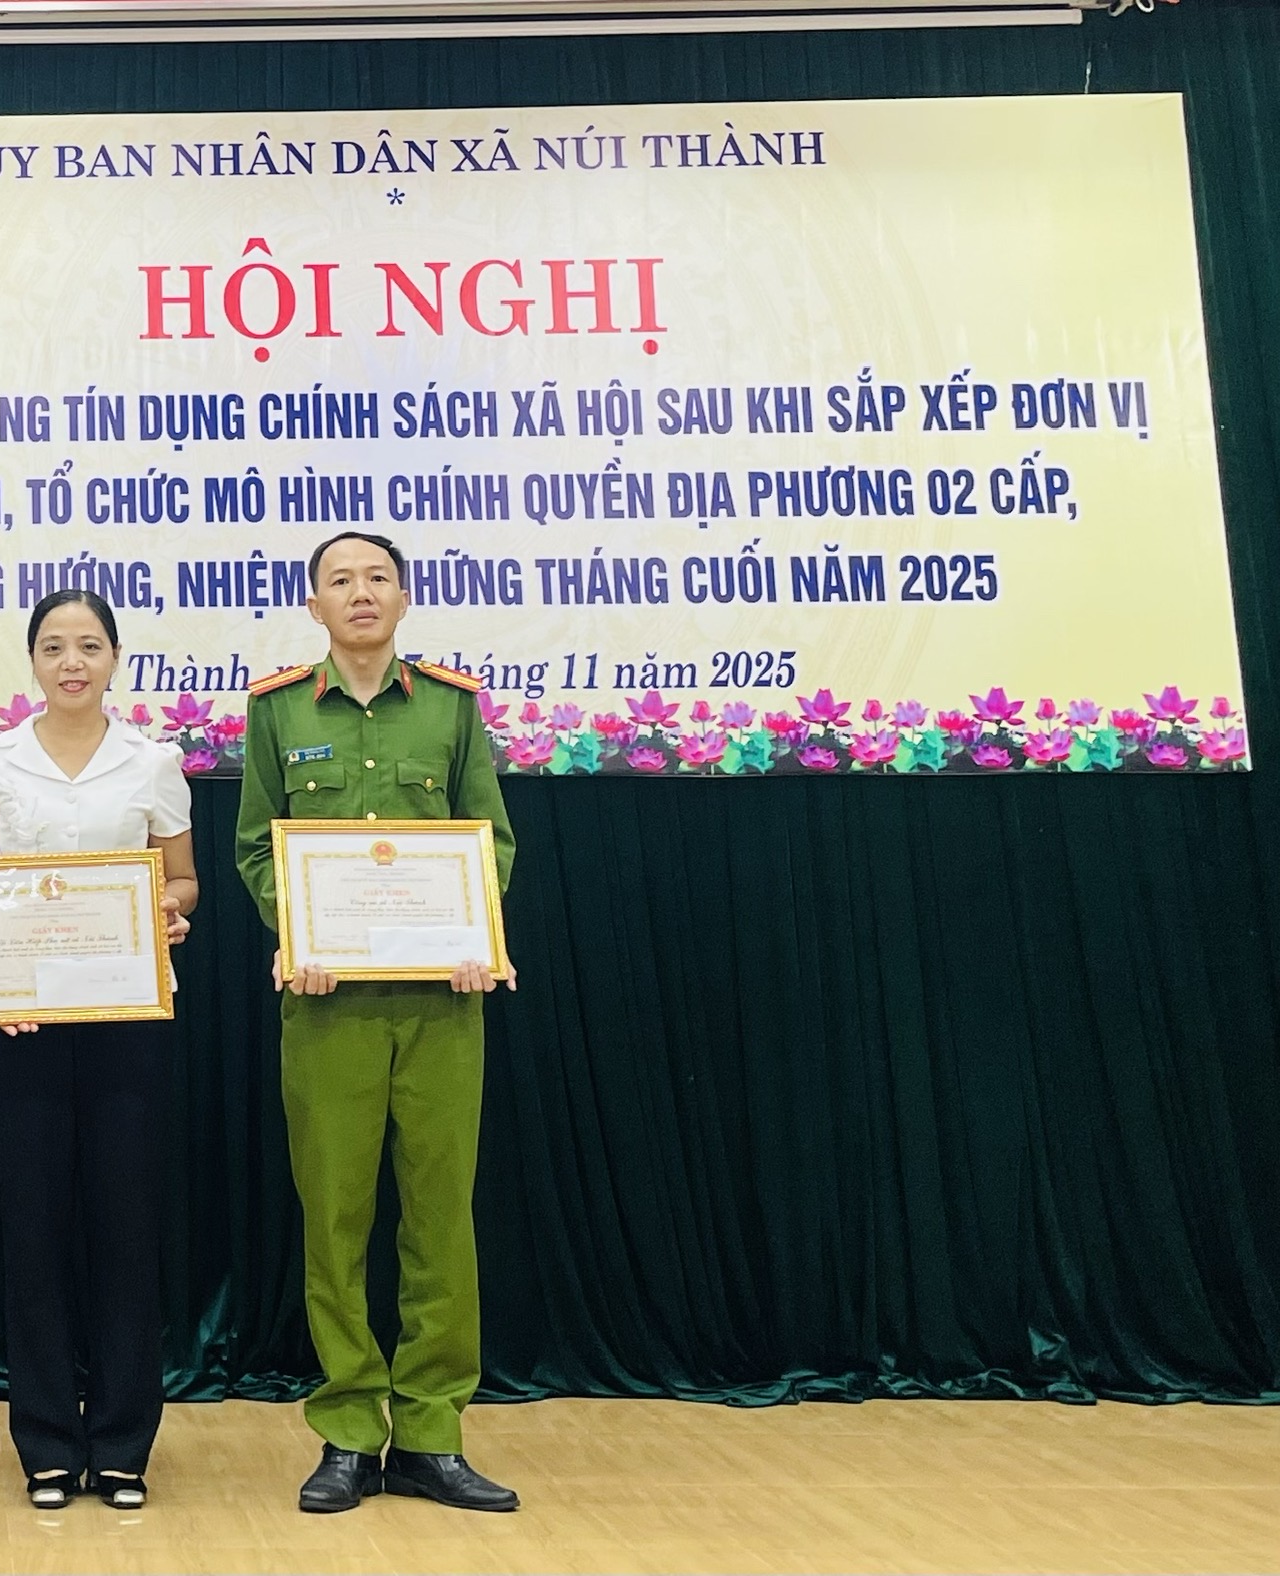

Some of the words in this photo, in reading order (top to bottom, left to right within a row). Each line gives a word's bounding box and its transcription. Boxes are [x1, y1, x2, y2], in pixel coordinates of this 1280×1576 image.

[54, 145, 155, 178] BAN
[173, 132, 315, 176] NHÂN
[332, 130, 437, 174] DÂN
[453, 129, 518, 171] XÃ
[535, 125, 632, 171] NÚI
[641, 122, 827, 169] THÀNH
[139, 238, 340, 362] HỘI
[376, 259, 667, 354] NGHỊ
[64, 386, 124, 441] TÍN
[139, 394, 245, 451] DỤNG
[260, 383, 378, 440] CHÍNH
[394, 382, 498, 438] SÁCH
[512, 381, 565, 436] XÃ
[578, 380, 642, 445] HỘI
[658, 388, 732, 435] SAU
[747, 387, 813, 433] KHI
[828, 368, 905, 432] SẮP
[921, 369, 997, 430] XẾP
[1012, 379, 1096, 428] ĐƠN
[1110, 383, 1147, 439] VỊ
[26, 460, 73, 524] TỔ
[87, 468, 189, 524] CHỨC
[205, 467, 265, 522] MÔ
[280, 467, 373, 522] HÌNH
[388, 465, 509, 521] CHÍNH
[524, 458, 654, 525] QUYỀN
[668, 472, 736, 528] ĐỊA
[748, 466, 914, 517] PHƯƠNG
[928, 470, 976, 515] 02
[990, 451, 1076, 519] CẤP,
[19, 551, 163, 618] HƯỚNG,
[178, 550, 306, 619] NHIỆM
[535, 547, 669, 604] THÁNG
[683, 538, 776, 603] CUỐI
[791, 544, 885, 602] NĂM
[900, 555, 997, 601] 2025
[561, 654, 597, 689] 11
[613, 654, 697, 689] năm
[710, 651, 795, 688] 2025
